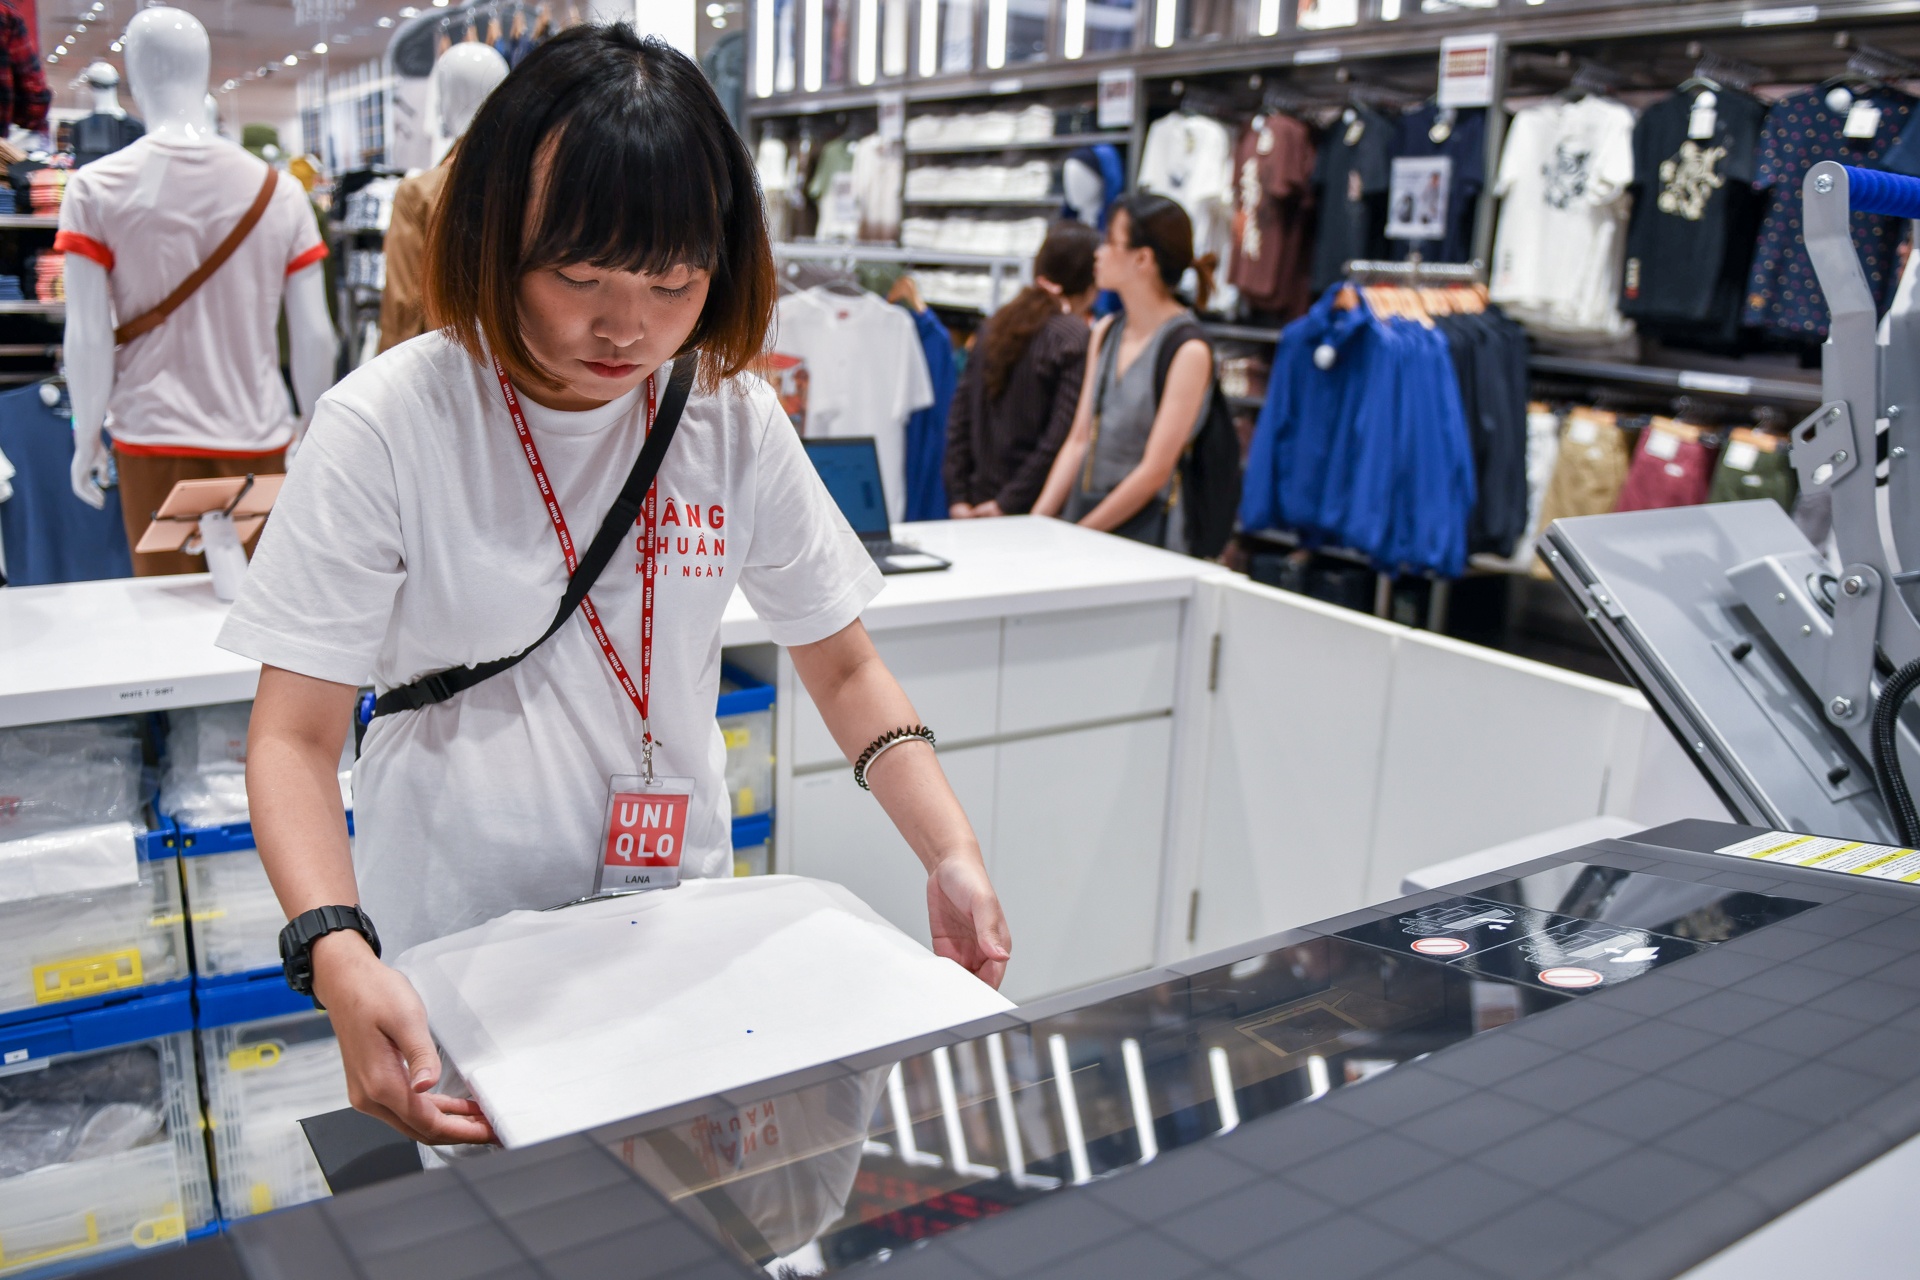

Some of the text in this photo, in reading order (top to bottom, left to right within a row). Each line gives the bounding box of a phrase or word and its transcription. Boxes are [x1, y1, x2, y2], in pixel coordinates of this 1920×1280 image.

[503, 383, 515, 405] UNIQLO
[513, 413, 526, 436] UNIQLO
[525, 443, 538, 466] UNIQLO
[536, 472, 550, 495] UNIQLO
[548, 502, 561, 524] UNIQLO
[560, 529, 571, 550] UNIQLO
[682, 563, 724, 578] NGÀY
[582, 598, 595, 619] UNIQLO
[594, 625, 608, 647] UNIQLO
[608, 652, 622, 672] UNIQLO
[622, 677, 637, 698] UNIQLO
[620, 802, 674, 828] UNI
[615, 832, 675, 861] QLO
[625, 875, 650, 884] LANA
